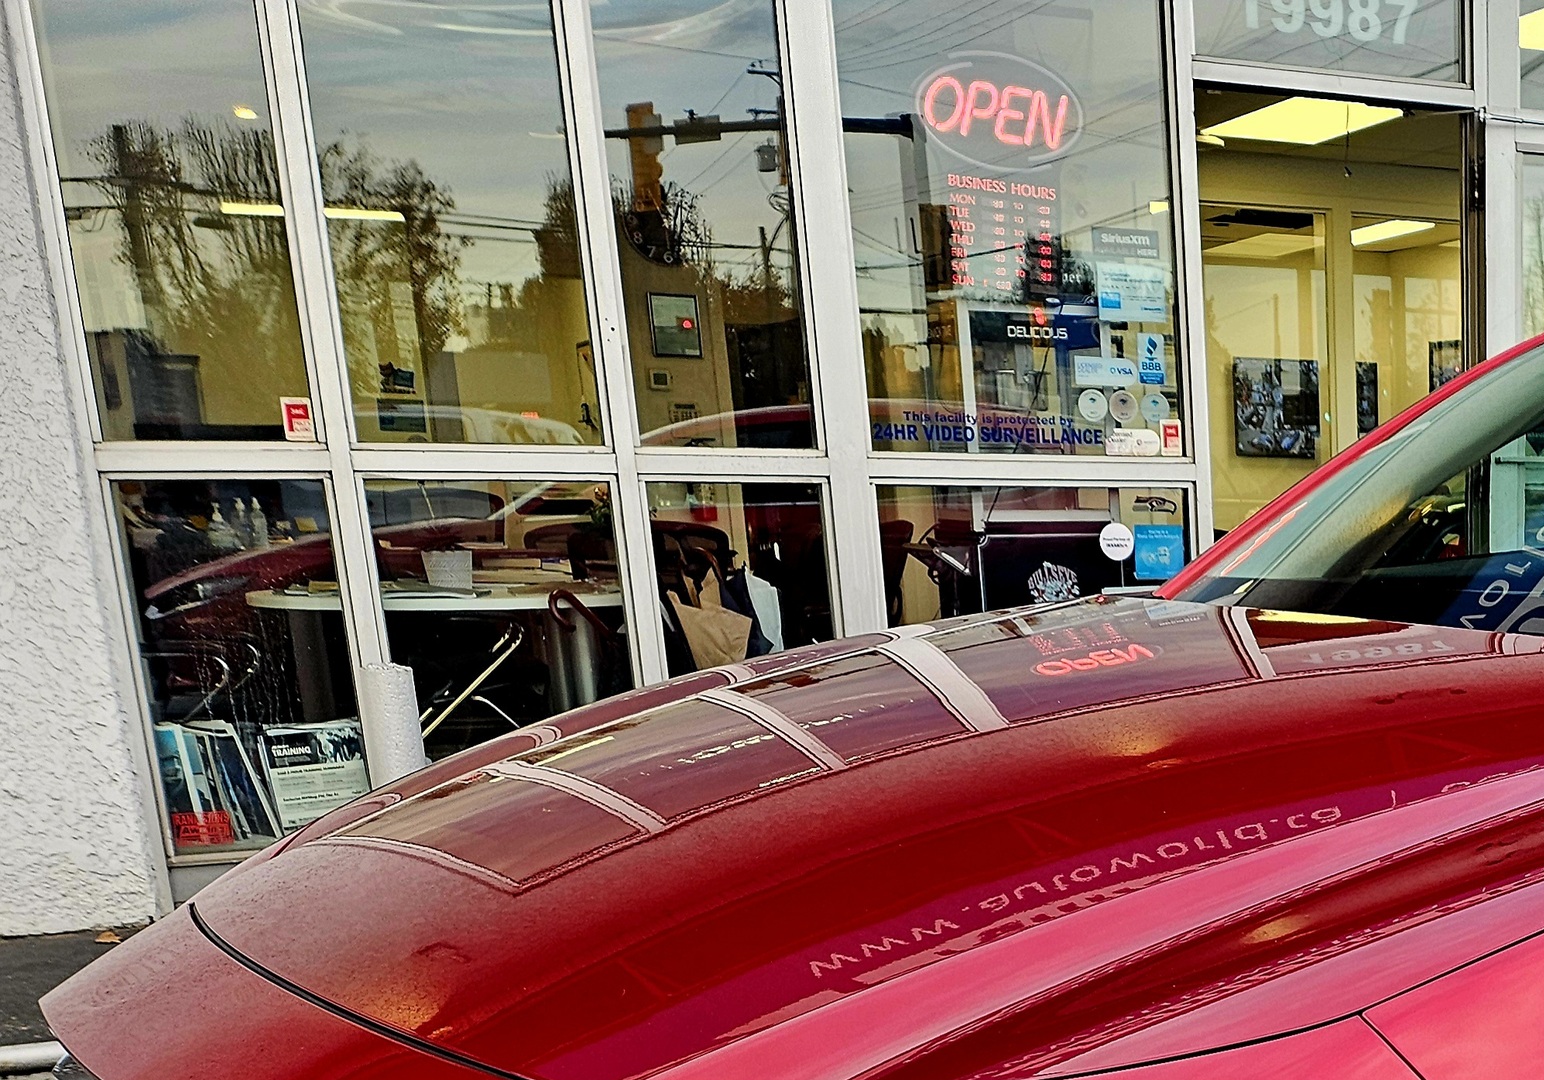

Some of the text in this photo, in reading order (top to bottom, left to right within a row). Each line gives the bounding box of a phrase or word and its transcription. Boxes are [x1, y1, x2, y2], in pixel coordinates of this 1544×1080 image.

[1245, 0, 1418, 45] 19987
[924, 76, 1069, 150] OPEN
[947, 174, 1056, 200] BUSINESS HOURS
[950, 193, 976, 205] MON
[950, 206, 969, 217] TUE
[950, 220, 976, 232] WED
[951, 233, 974, 245] THU
[1137, 248, 1158, 257] HERE
[952, 261, 970, 272] SAT
[952, 274, 975, 286] SUN
[1007, 325, 1068, 340] DELICIOUS
[1117, 368, 1133, 376] VSA
[1141, 362, 1162, 371] BBB
[903, 411, 1074, 428] This facility is protected by
[873, 423, 1104, 445] 24HR VIDEO SURVEILLANCE
[272, 746, 311, 757] TRAINING
